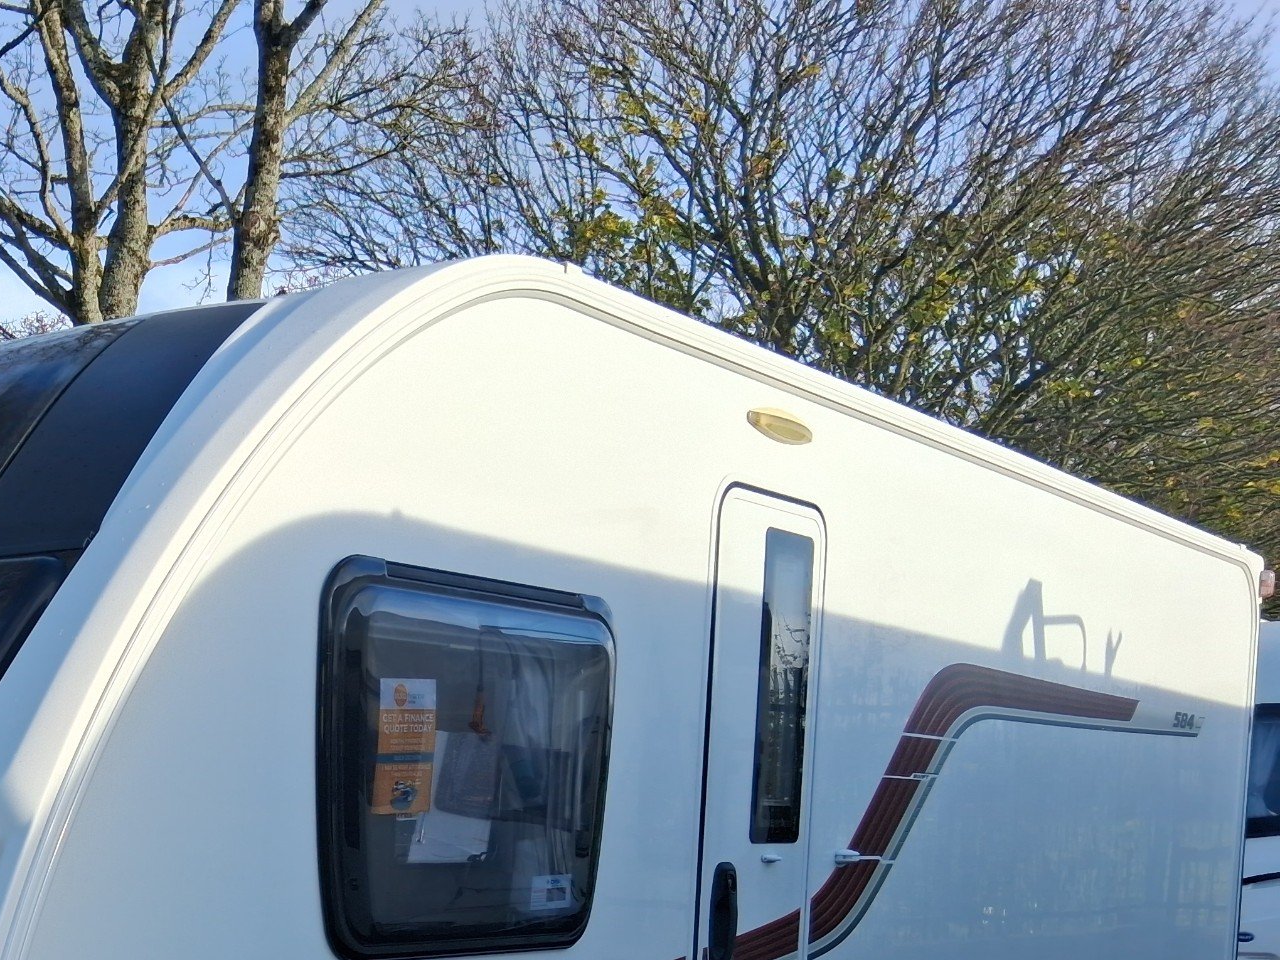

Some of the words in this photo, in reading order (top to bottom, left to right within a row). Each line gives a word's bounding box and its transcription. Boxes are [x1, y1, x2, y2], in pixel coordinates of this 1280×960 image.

[382, 713, 396, 722] GET
[404, 713, 434, 722] FINANCE
[1173, 711, 1195, 730] 584
[383, 724, 408, 734] QUOTE
[409, 724, 432, 733] TODAY
